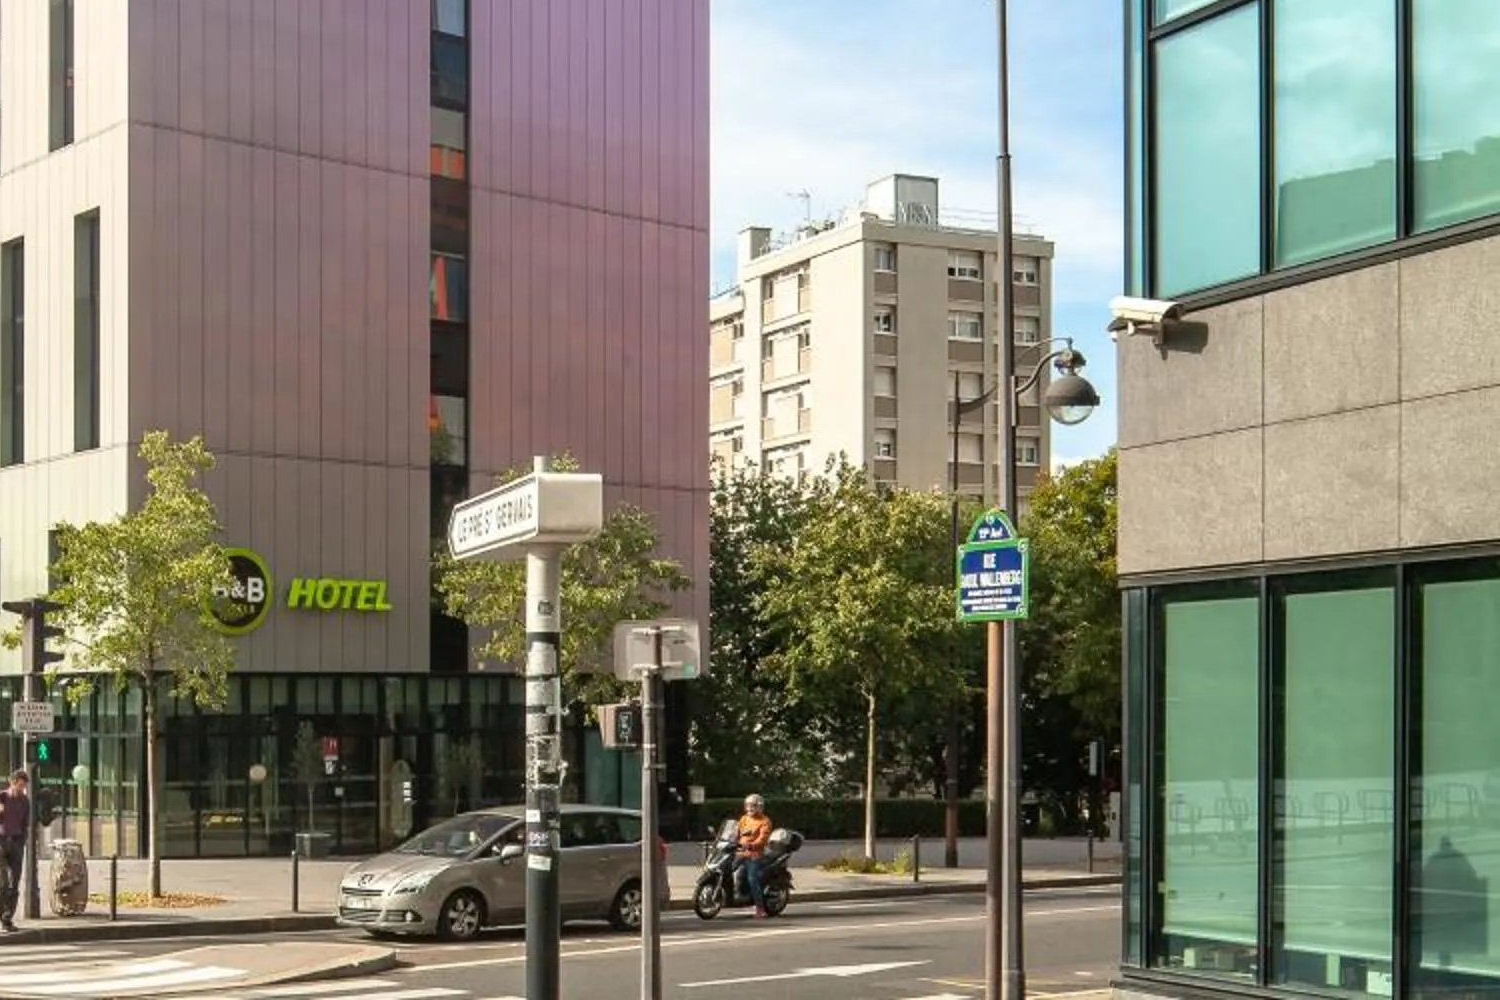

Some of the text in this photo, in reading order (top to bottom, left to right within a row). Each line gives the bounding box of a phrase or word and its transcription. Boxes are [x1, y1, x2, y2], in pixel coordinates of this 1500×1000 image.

[458, 517, 468, 543] LE
[496, 493, 533, 530] GERVAIS
[287, 577, 393, 612] HOTEL
